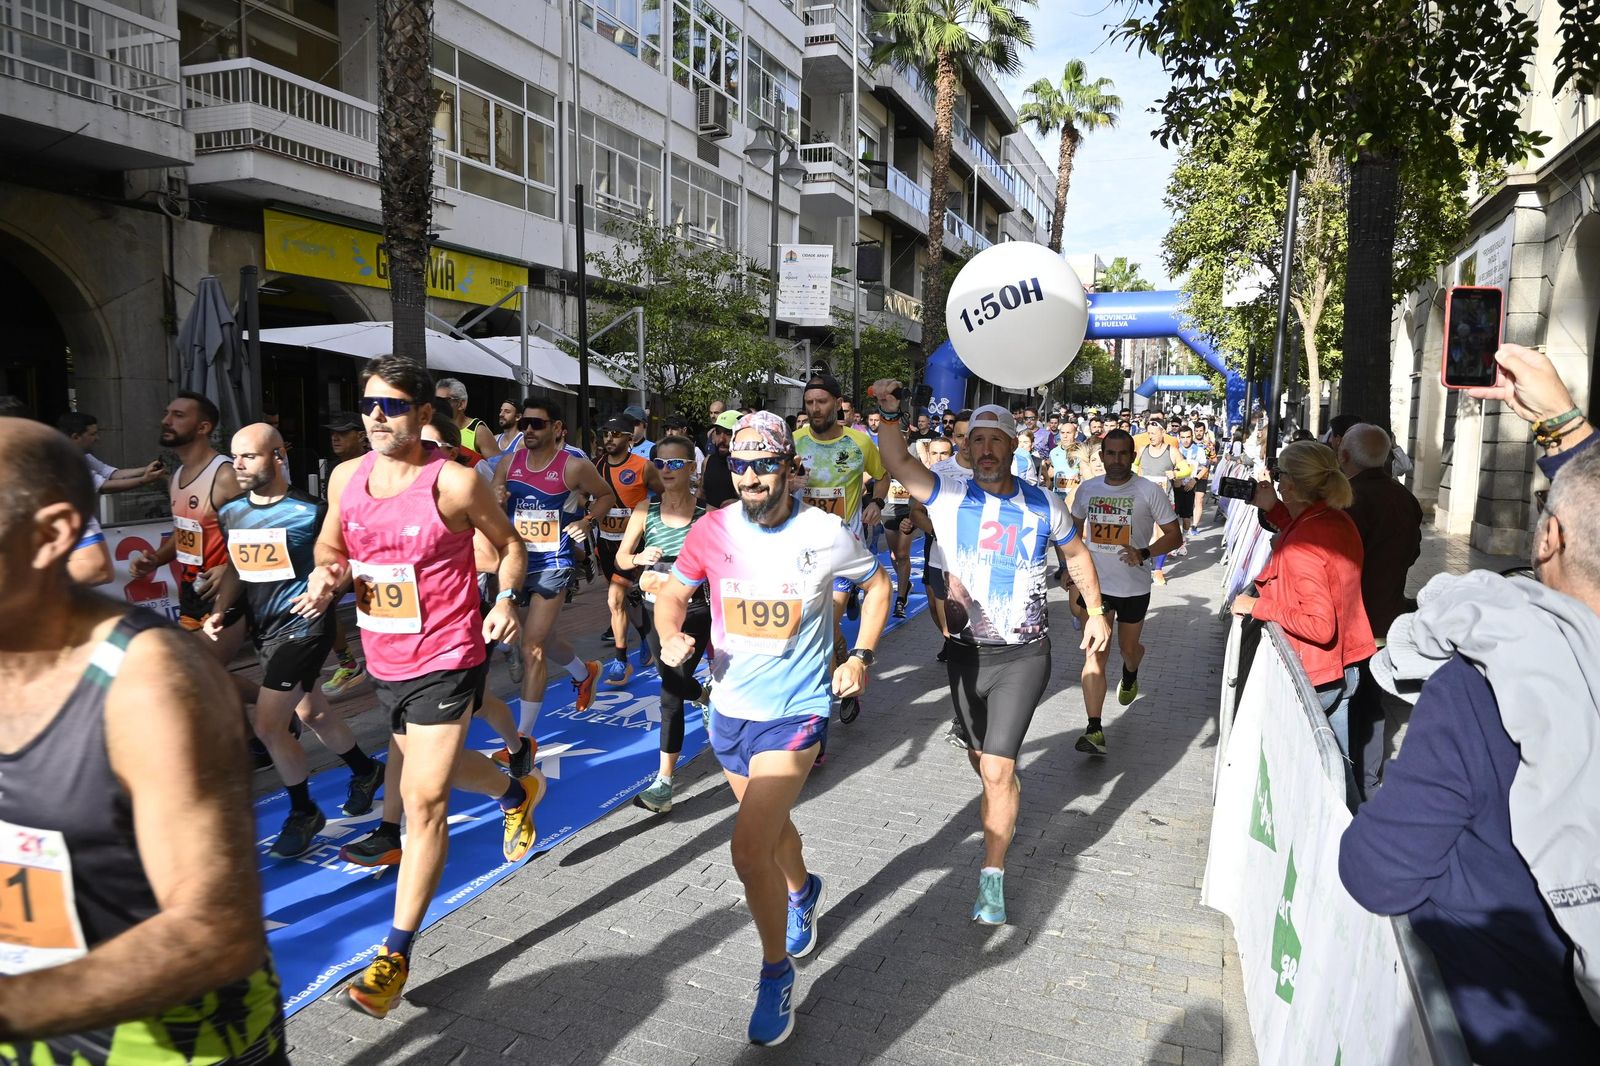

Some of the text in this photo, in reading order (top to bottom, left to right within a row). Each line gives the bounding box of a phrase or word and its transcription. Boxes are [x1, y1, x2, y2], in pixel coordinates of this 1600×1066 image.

[960, 277, 1044, 333] 1:50H
[1094, 313, 1137, 322] PROVINCIAL
[520, 520, 551, 537] 550
[602, 517, 624, 529] 407
[1094, 524, 1123, 539] 217
[979, 520, 1035, 561] 21K
[238, 543, 279, 563] 572
[978, 553, 1028, 571] HUELVA
[736, 600, 790, 628] 199
[545, 709, 653, 731] HUELVA
